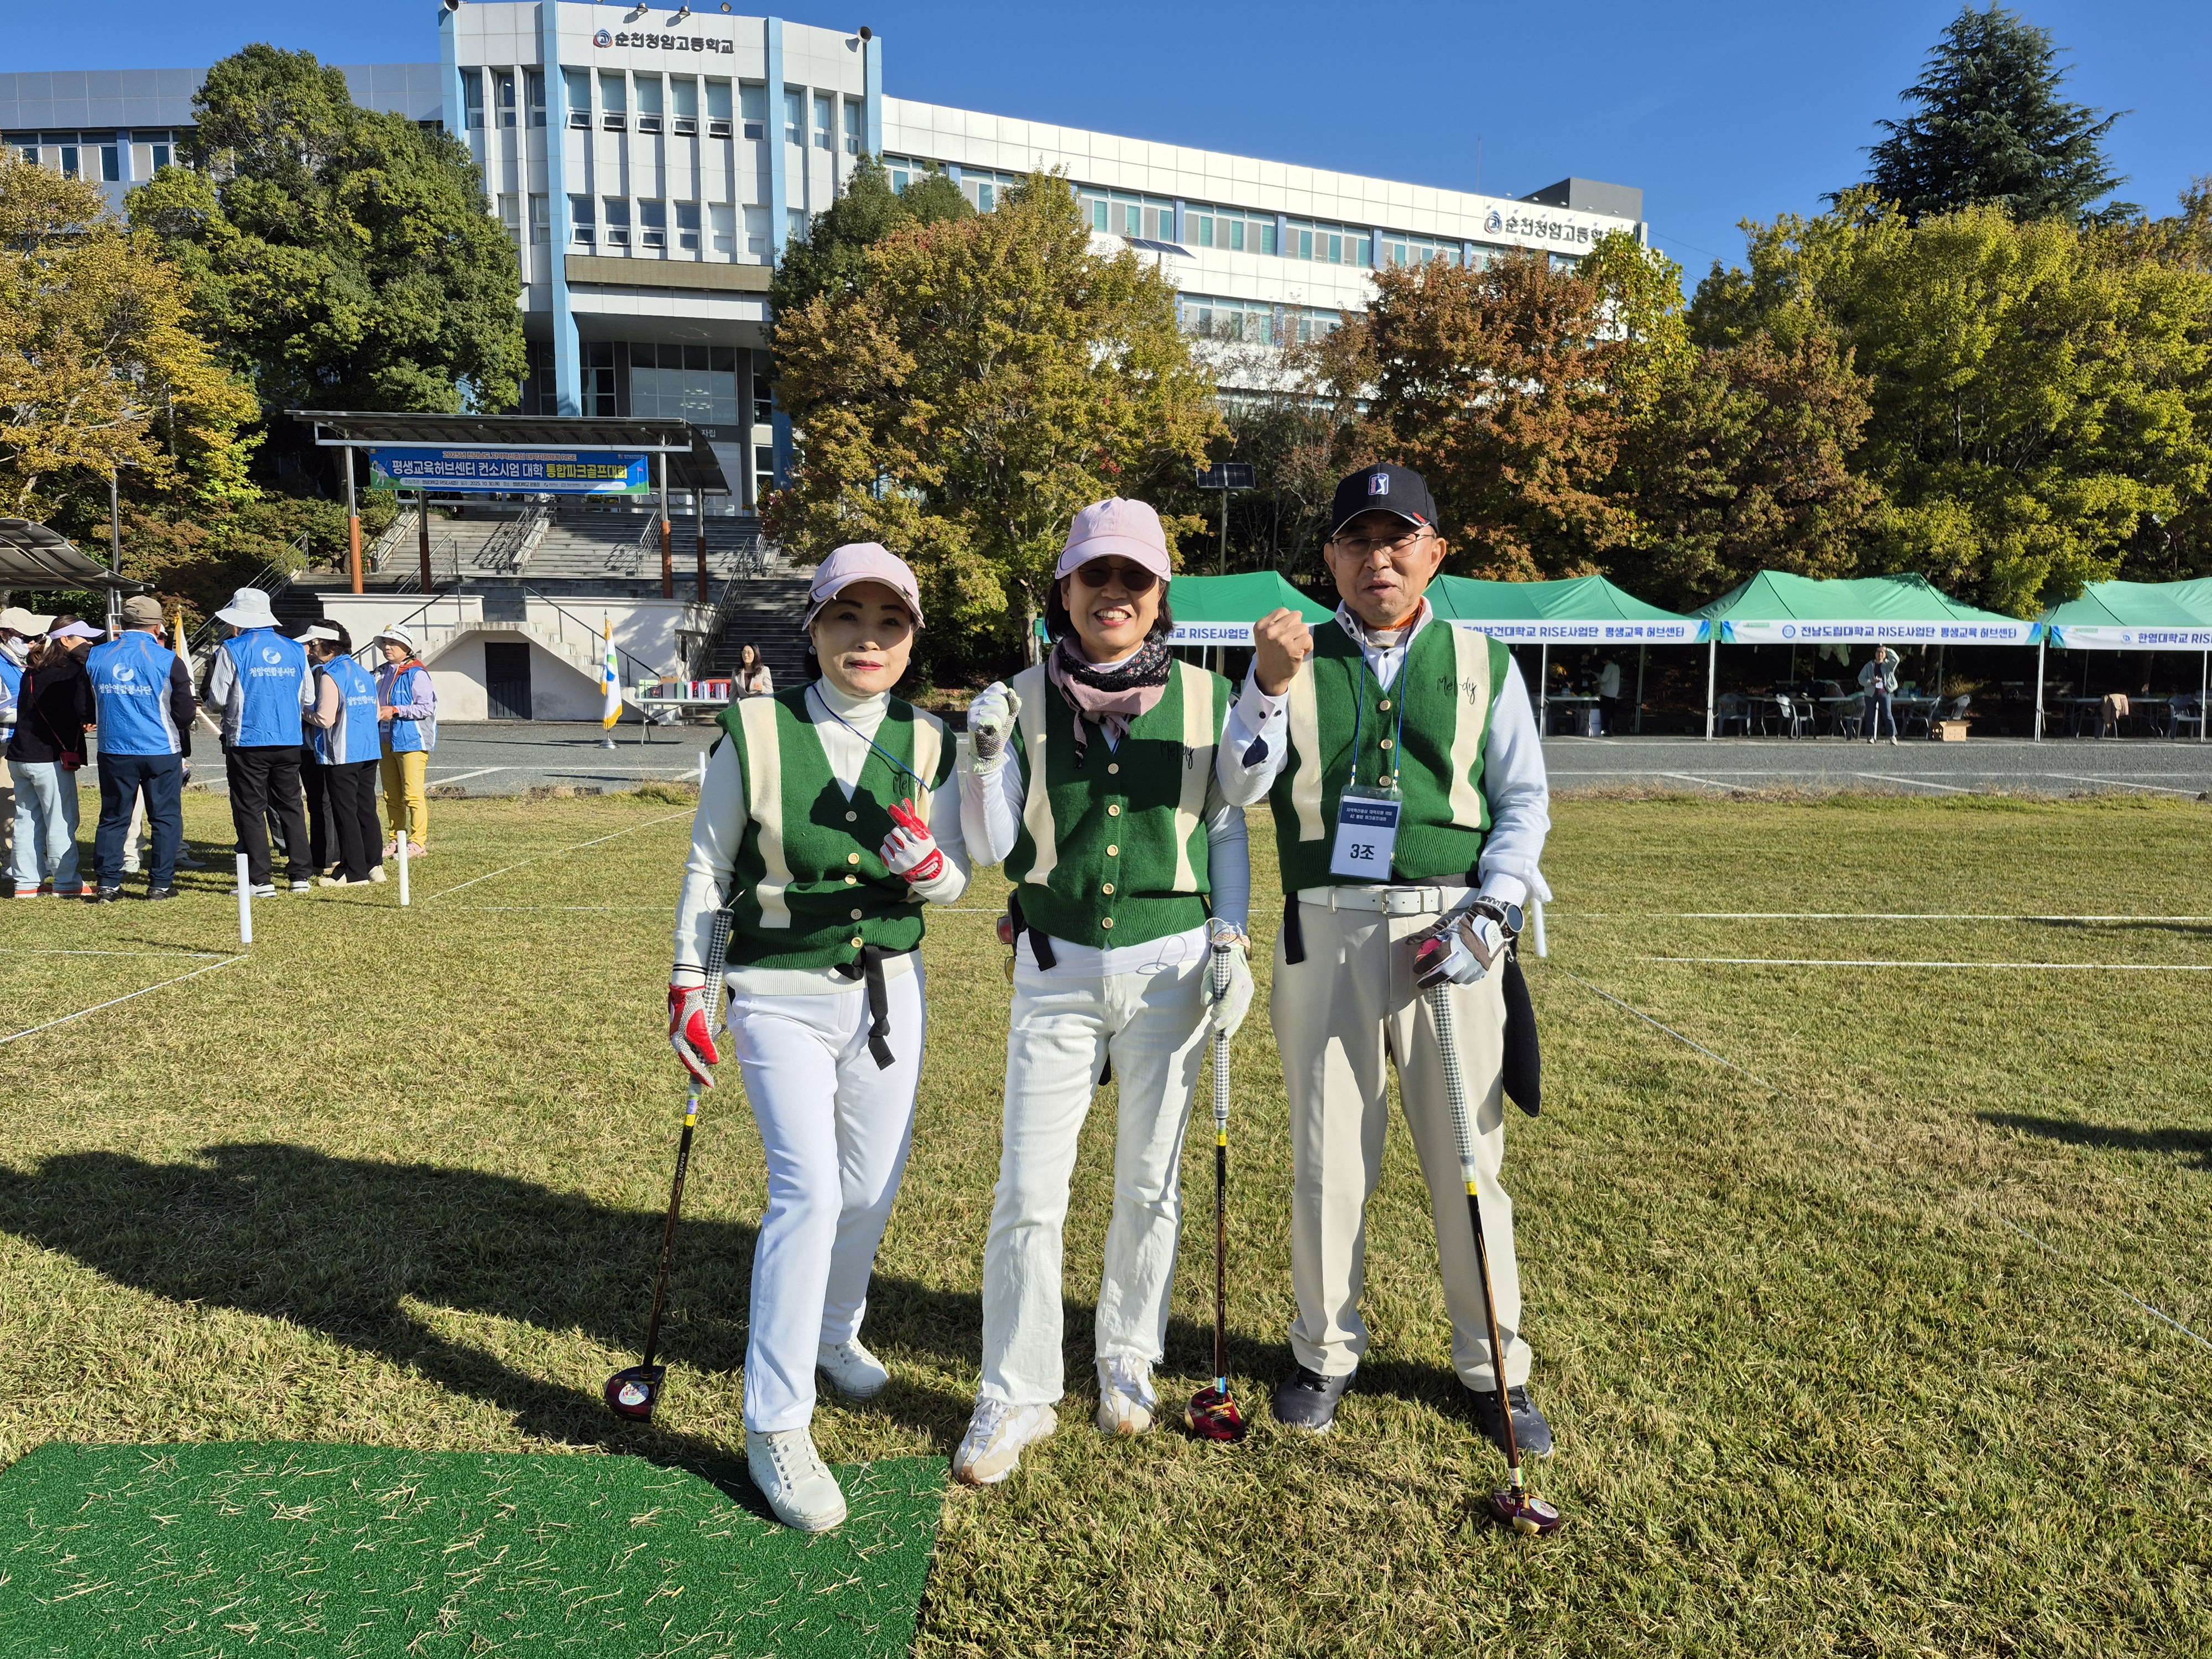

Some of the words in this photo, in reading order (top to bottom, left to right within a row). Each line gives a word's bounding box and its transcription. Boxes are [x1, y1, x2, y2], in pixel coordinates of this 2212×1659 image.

[614, 32, 735, 54] 순천청암고등학교
[443, 451, 467, 459] 2025년
[467, 451, 491, 460] 전라남도
[392, 460, 476, 477] 평생교육허브센터
[478, 462, 519, 477] 컨소시엄
[522, 463, 544, 478] 대학
[546, 463, 628, 479] 통합파크골프대회
[1190, 628, 1249, 639] RISE사업단
[1540, 627, 1599, 638] RISE사업단
[1605, 627, 1644, 638] 평생교육
[1647, 627, 1685, 638] 허브센터
[1801, 626, 1874, 637] 전남도립대학교
[1878, 627, 1936, 638] RISE사업단
[1940, 627, 1978, 639] 평생교육
[1980, 627, 2017, 639] 허브센터
[2138, 633, 2188, 644] 한영대학교
[2191, 633, 2212, 644] RIS
[250, 666, 296, 677] 청암연합봉사단
[98, 684, 153, 696] 청암연합봉사단
[1350, 843, 1375, 860] 3조
